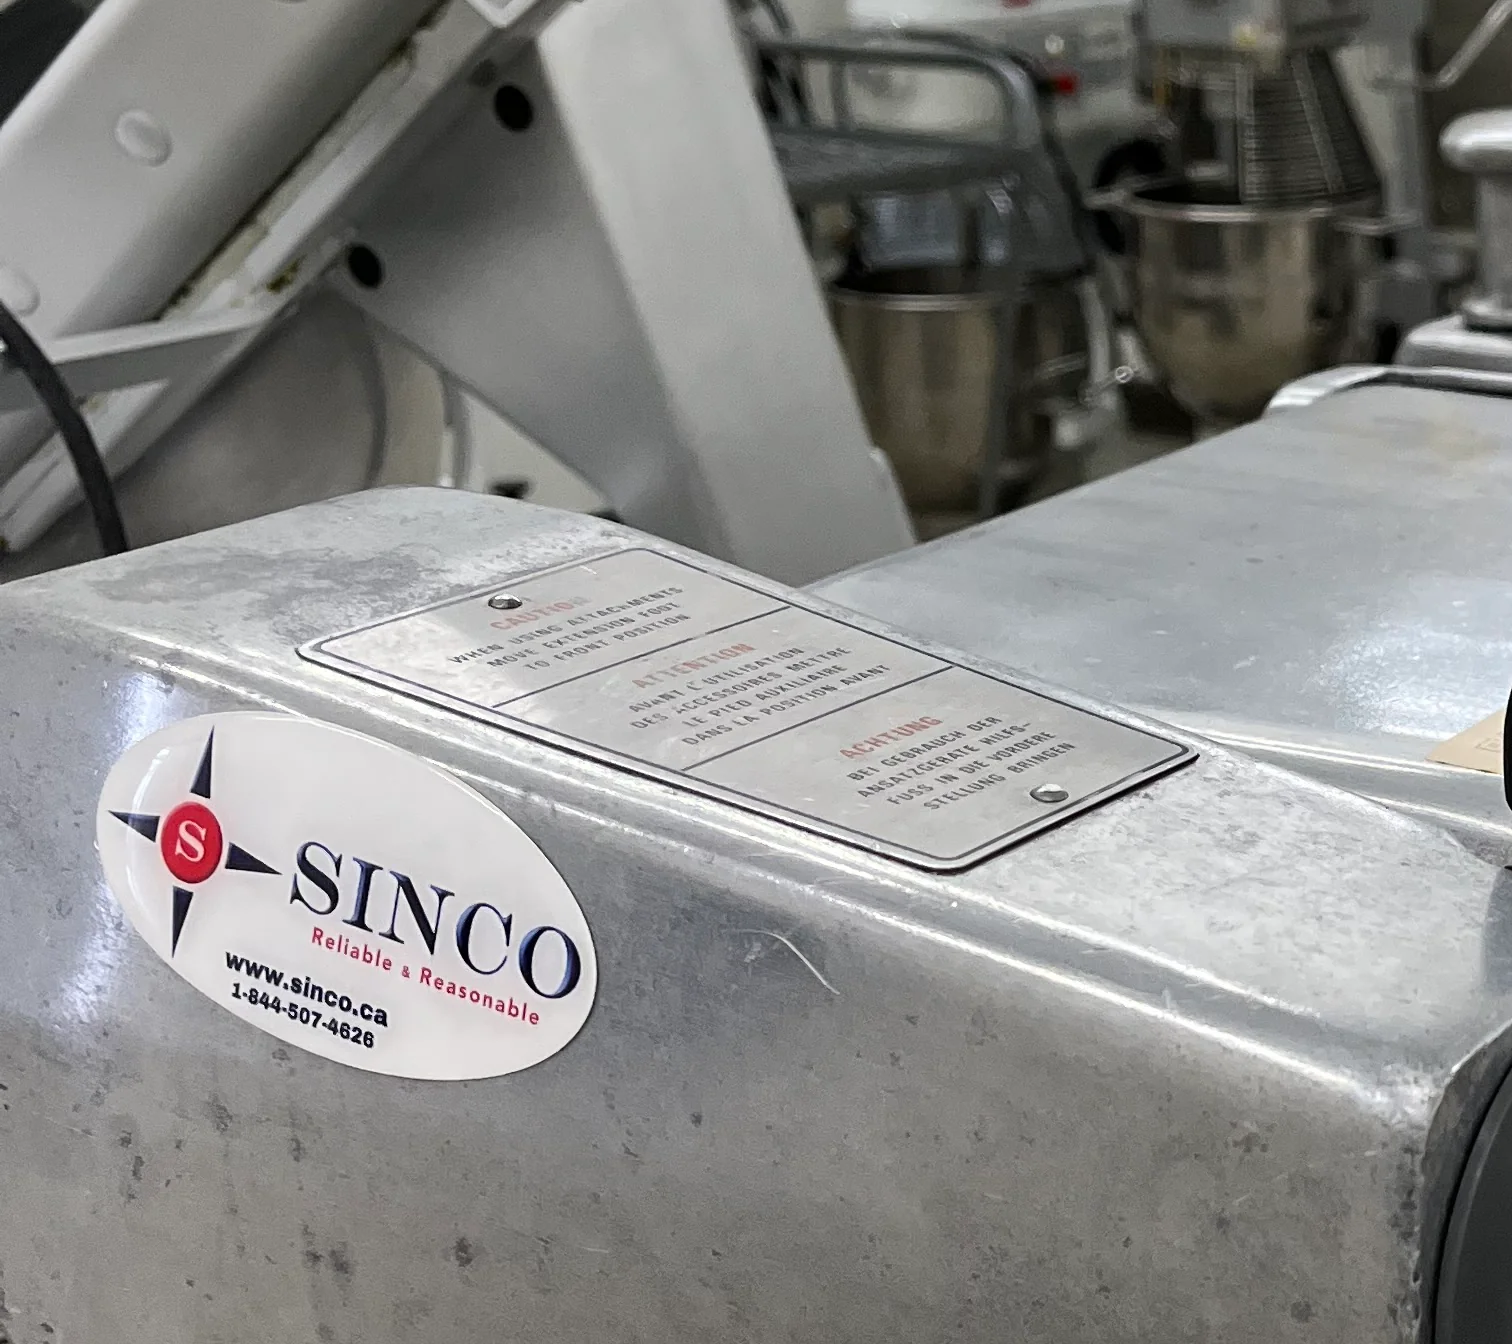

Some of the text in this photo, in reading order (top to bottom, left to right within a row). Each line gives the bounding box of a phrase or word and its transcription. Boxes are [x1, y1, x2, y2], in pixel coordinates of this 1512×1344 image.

[447, 586, 683, 664] WHEN USING ATTACHMENTS
[487, 601, 681, 667] MOVE EXTENSION FOOT
[523, 613, 692, 670] TO FRONT POSITION
[630, 647, 852, 729] DES ACCESSOIRES METTRE
[631, 643, 757, 688] ATTENTION
[682, 664, 848, 727] LE PIED AUXILIAIRE
[629, 689, 686, 712] AVANT
[682, 664, 891, 745] DANS LA POSITION AVANT
[979, 722, 1031, 746] HILFS-
[840, 716, 943, 759] ACHTUNG
[847, 716, 1002, 781] BEI GEBRAUCH DER
[887, 731, 1057, 805] FUSS IN DIE VORDERE
[924, 742, 1077, 810] STELLUNG BRINGEN
[174, 819, 207, 863] S
[290, 841, 582, 1000] SINCO
[225, 951, 388, 1028] www.sinco.ca
[311, 926, 540, 1026] Reliable & Reasonable
[231, 981, 375, 1049] 1-844-507-4626
